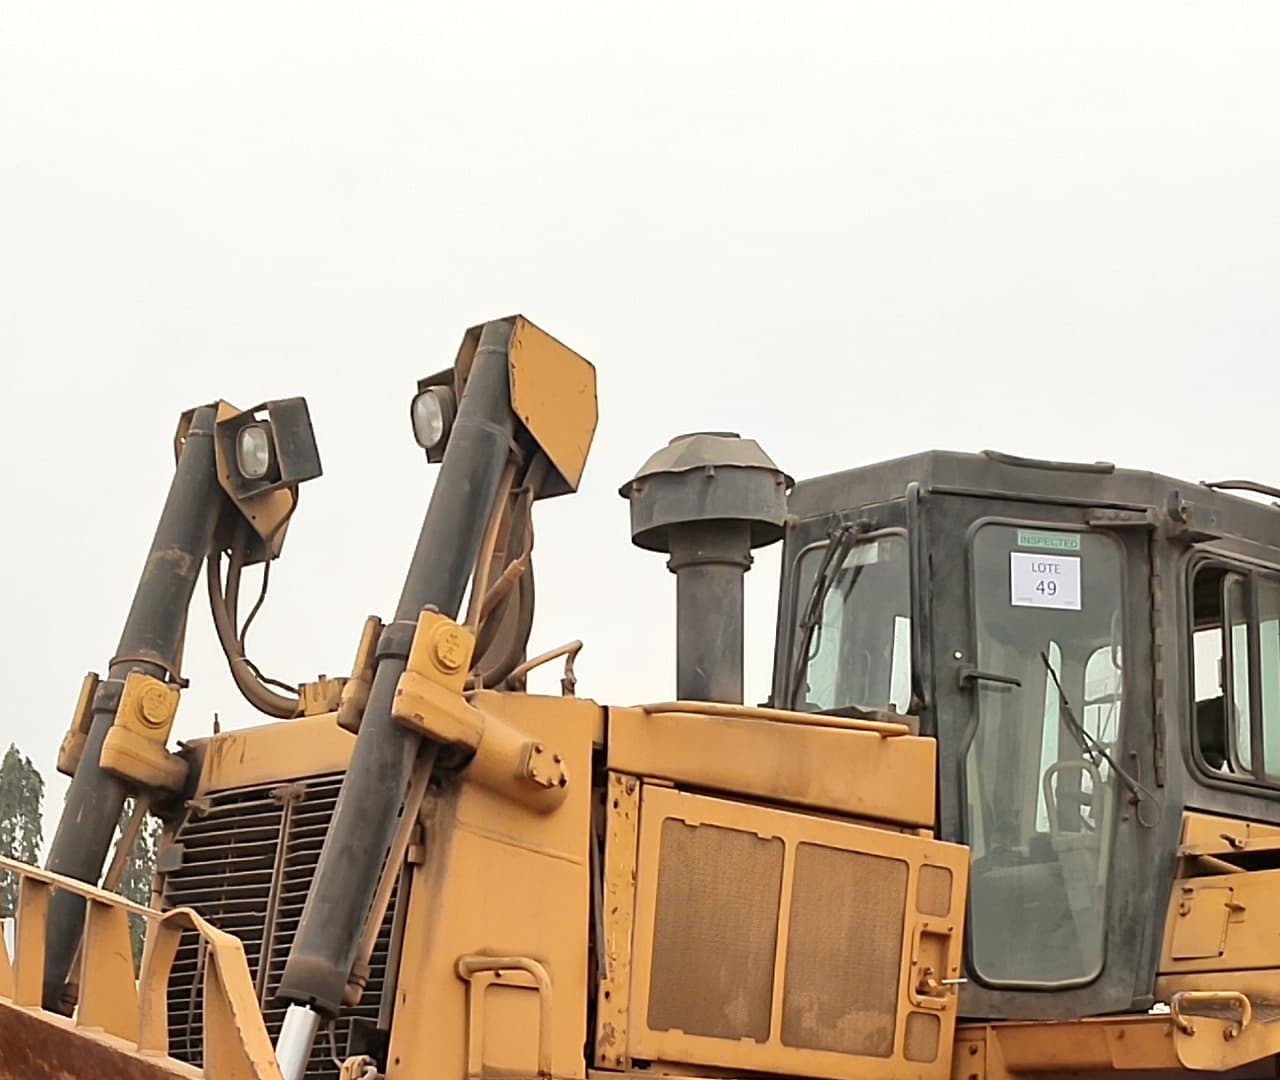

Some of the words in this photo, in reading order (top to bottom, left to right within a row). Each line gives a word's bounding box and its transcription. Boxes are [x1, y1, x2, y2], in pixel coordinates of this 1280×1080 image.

[1019, 535, 1078, 549] INSPECTED
[1031, 562, 1061, 575] LOTE
[1035, 580, 1057, 596] 49
